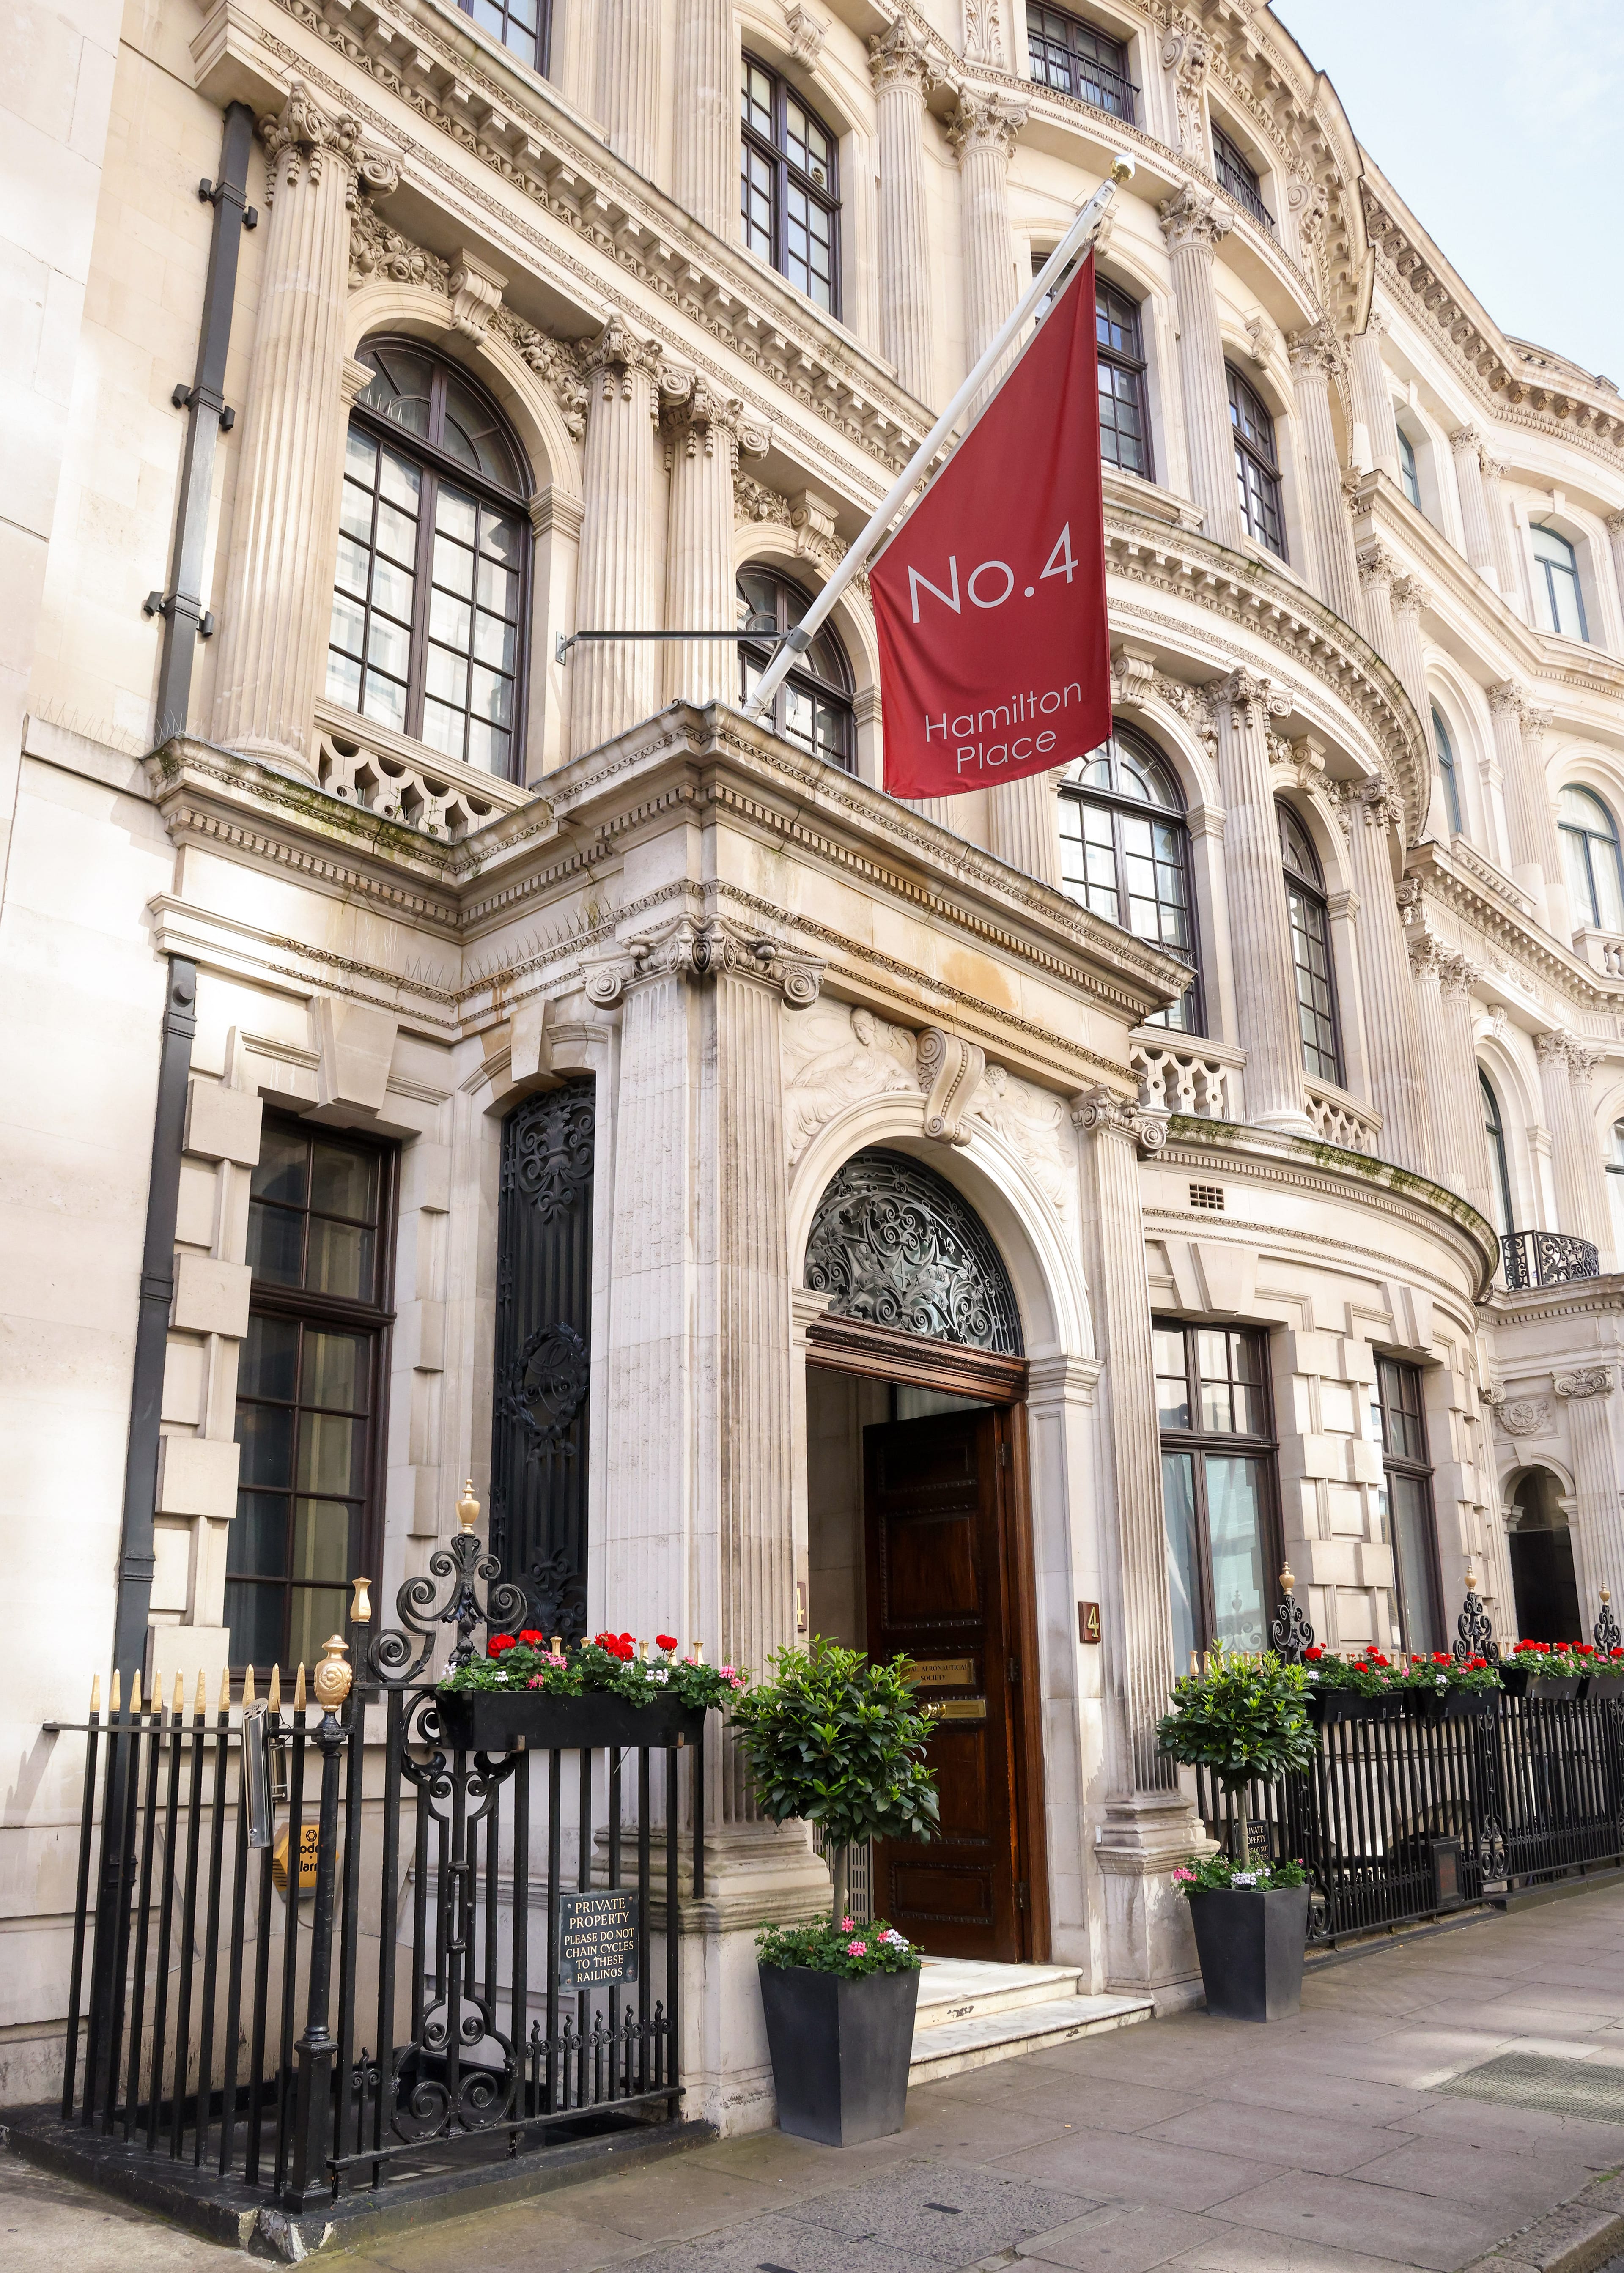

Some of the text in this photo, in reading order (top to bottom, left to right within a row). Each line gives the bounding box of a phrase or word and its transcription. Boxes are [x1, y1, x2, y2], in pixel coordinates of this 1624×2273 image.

[908, 521, 1079, 623] No.4
[924, 683, 1081, 742] Hamilton
[957, 730, 1056, 774] Place
[1087, 1606, 1099, 1637] 4
[1248, 1835, 1266, 1844] OPERTY
[1254, 1853, 1269, 1862] CCLES
[575, 1897, 625, 1914] PRIVATE
[569, 1911, 630, 1929] PROPERTY
[564, 1928, 634, 1946] PLEASE DO NOT
[565, 1941, 634, 1958] CHAIN CYCLES
[576, 1955, 624, 1969] TO THESE
[576, 1967, 623, 1982] RAILINGS
